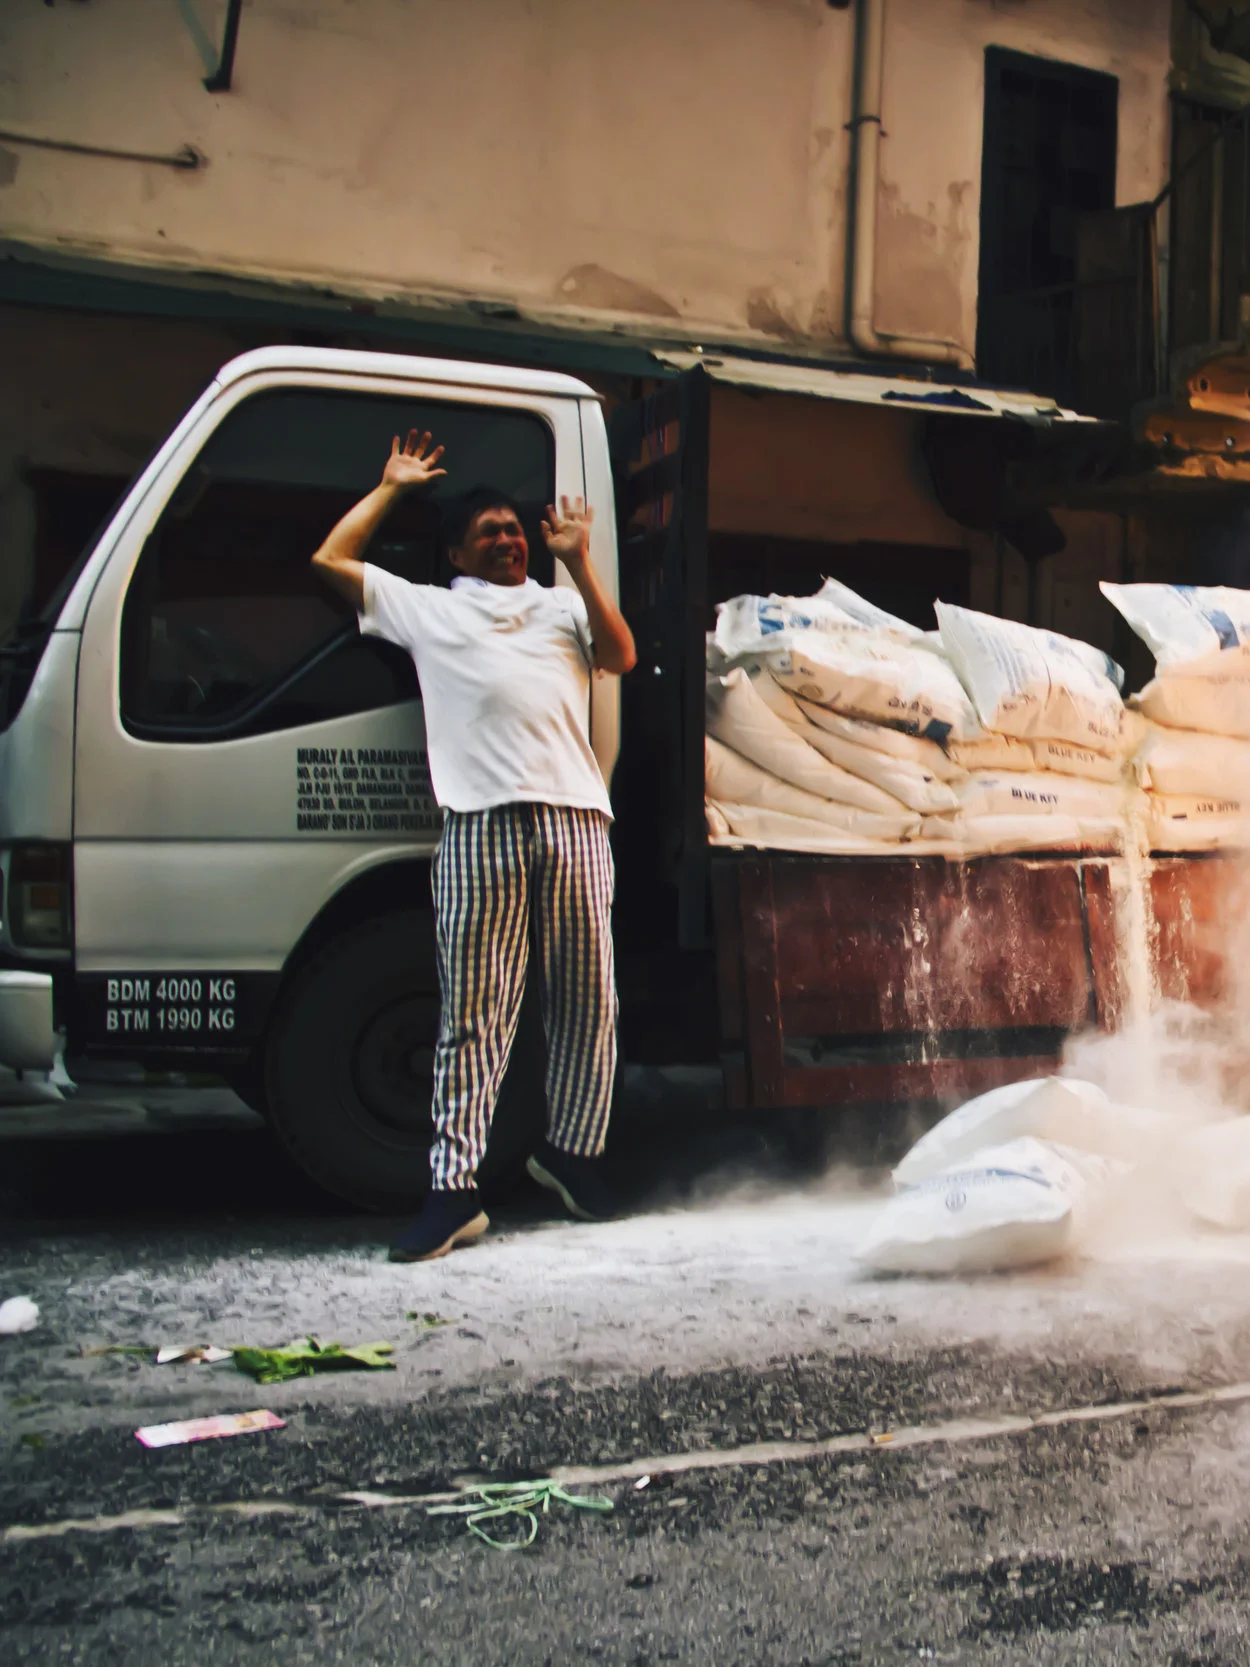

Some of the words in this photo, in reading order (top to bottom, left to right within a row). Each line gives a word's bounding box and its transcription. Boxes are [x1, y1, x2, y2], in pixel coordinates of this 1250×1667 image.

[297, 747, 337, 765] MURALY
[1011, 786, 1037, 803] BLUE
[107, 979, 150, 1001] BDM
[156, 978, 202, 1001] 4000
[208, 979, 236, 1001] KG
[106, 1008, 149, 1030] BTM
[156, 1008, 201, 1030] 1990
[208, 1008, 235, 1030] KG
